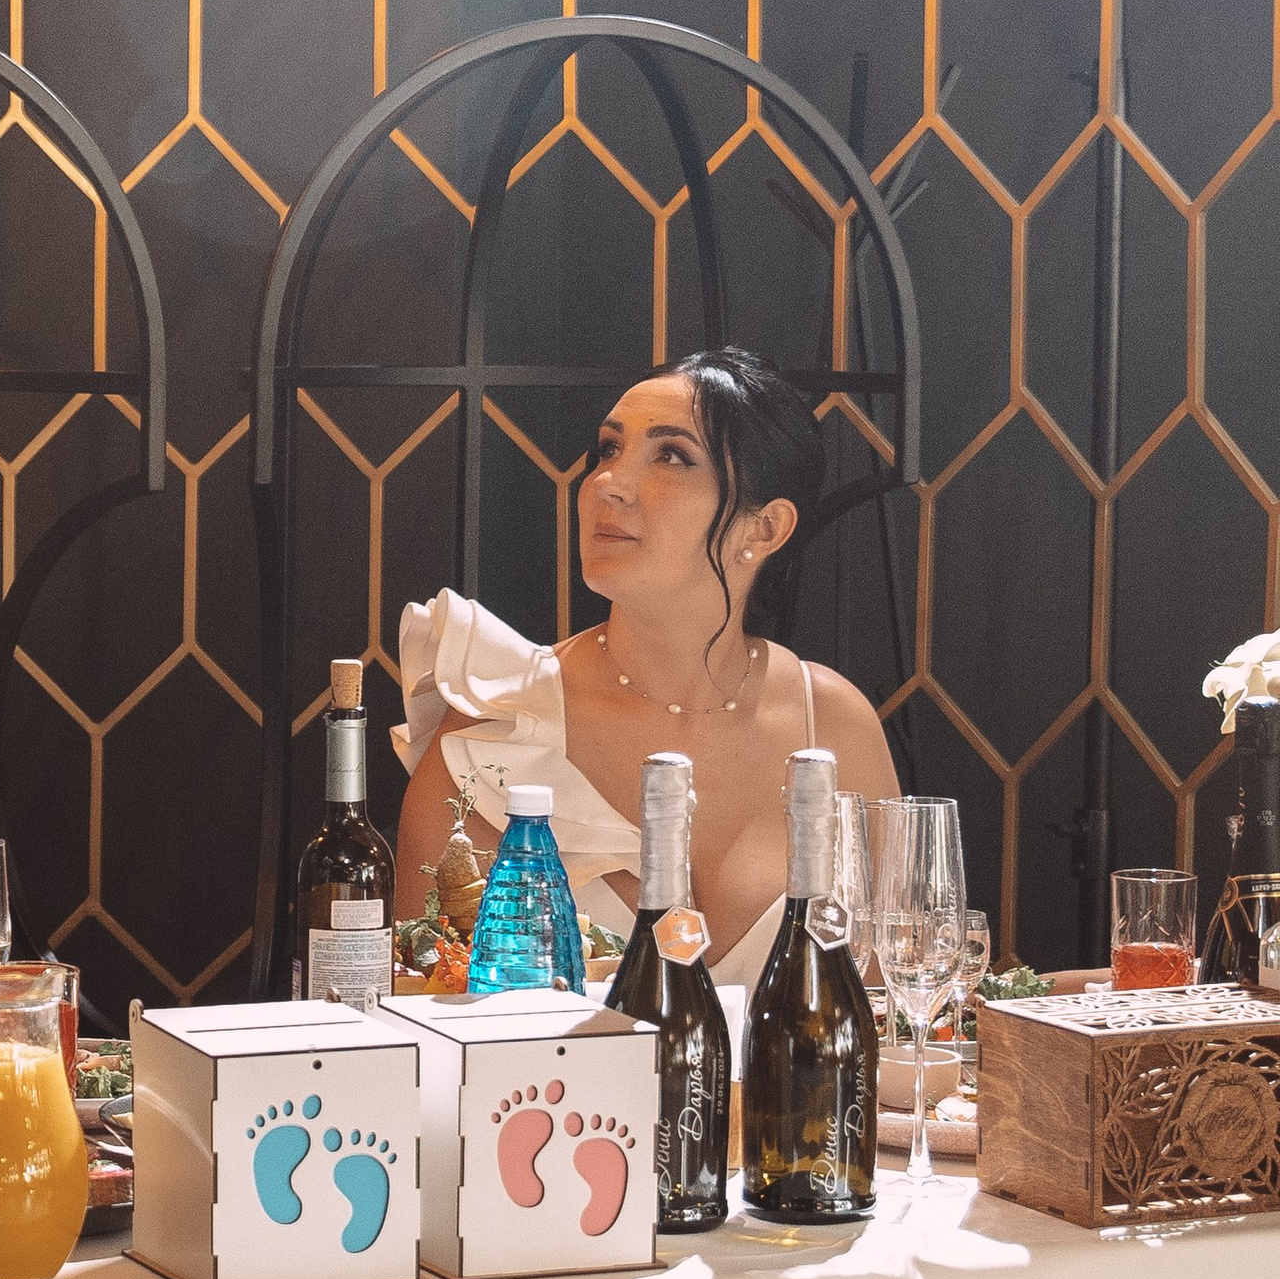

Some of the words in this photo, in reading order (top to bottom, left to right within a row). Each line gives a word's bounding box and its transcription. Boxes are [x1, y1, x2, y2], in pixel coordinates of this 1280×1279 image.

[677, 1050, 712, 1141] Дарья
[844, 1047, 872, 1139] Дарья
[809, 1115, 838, 1194] Денис
